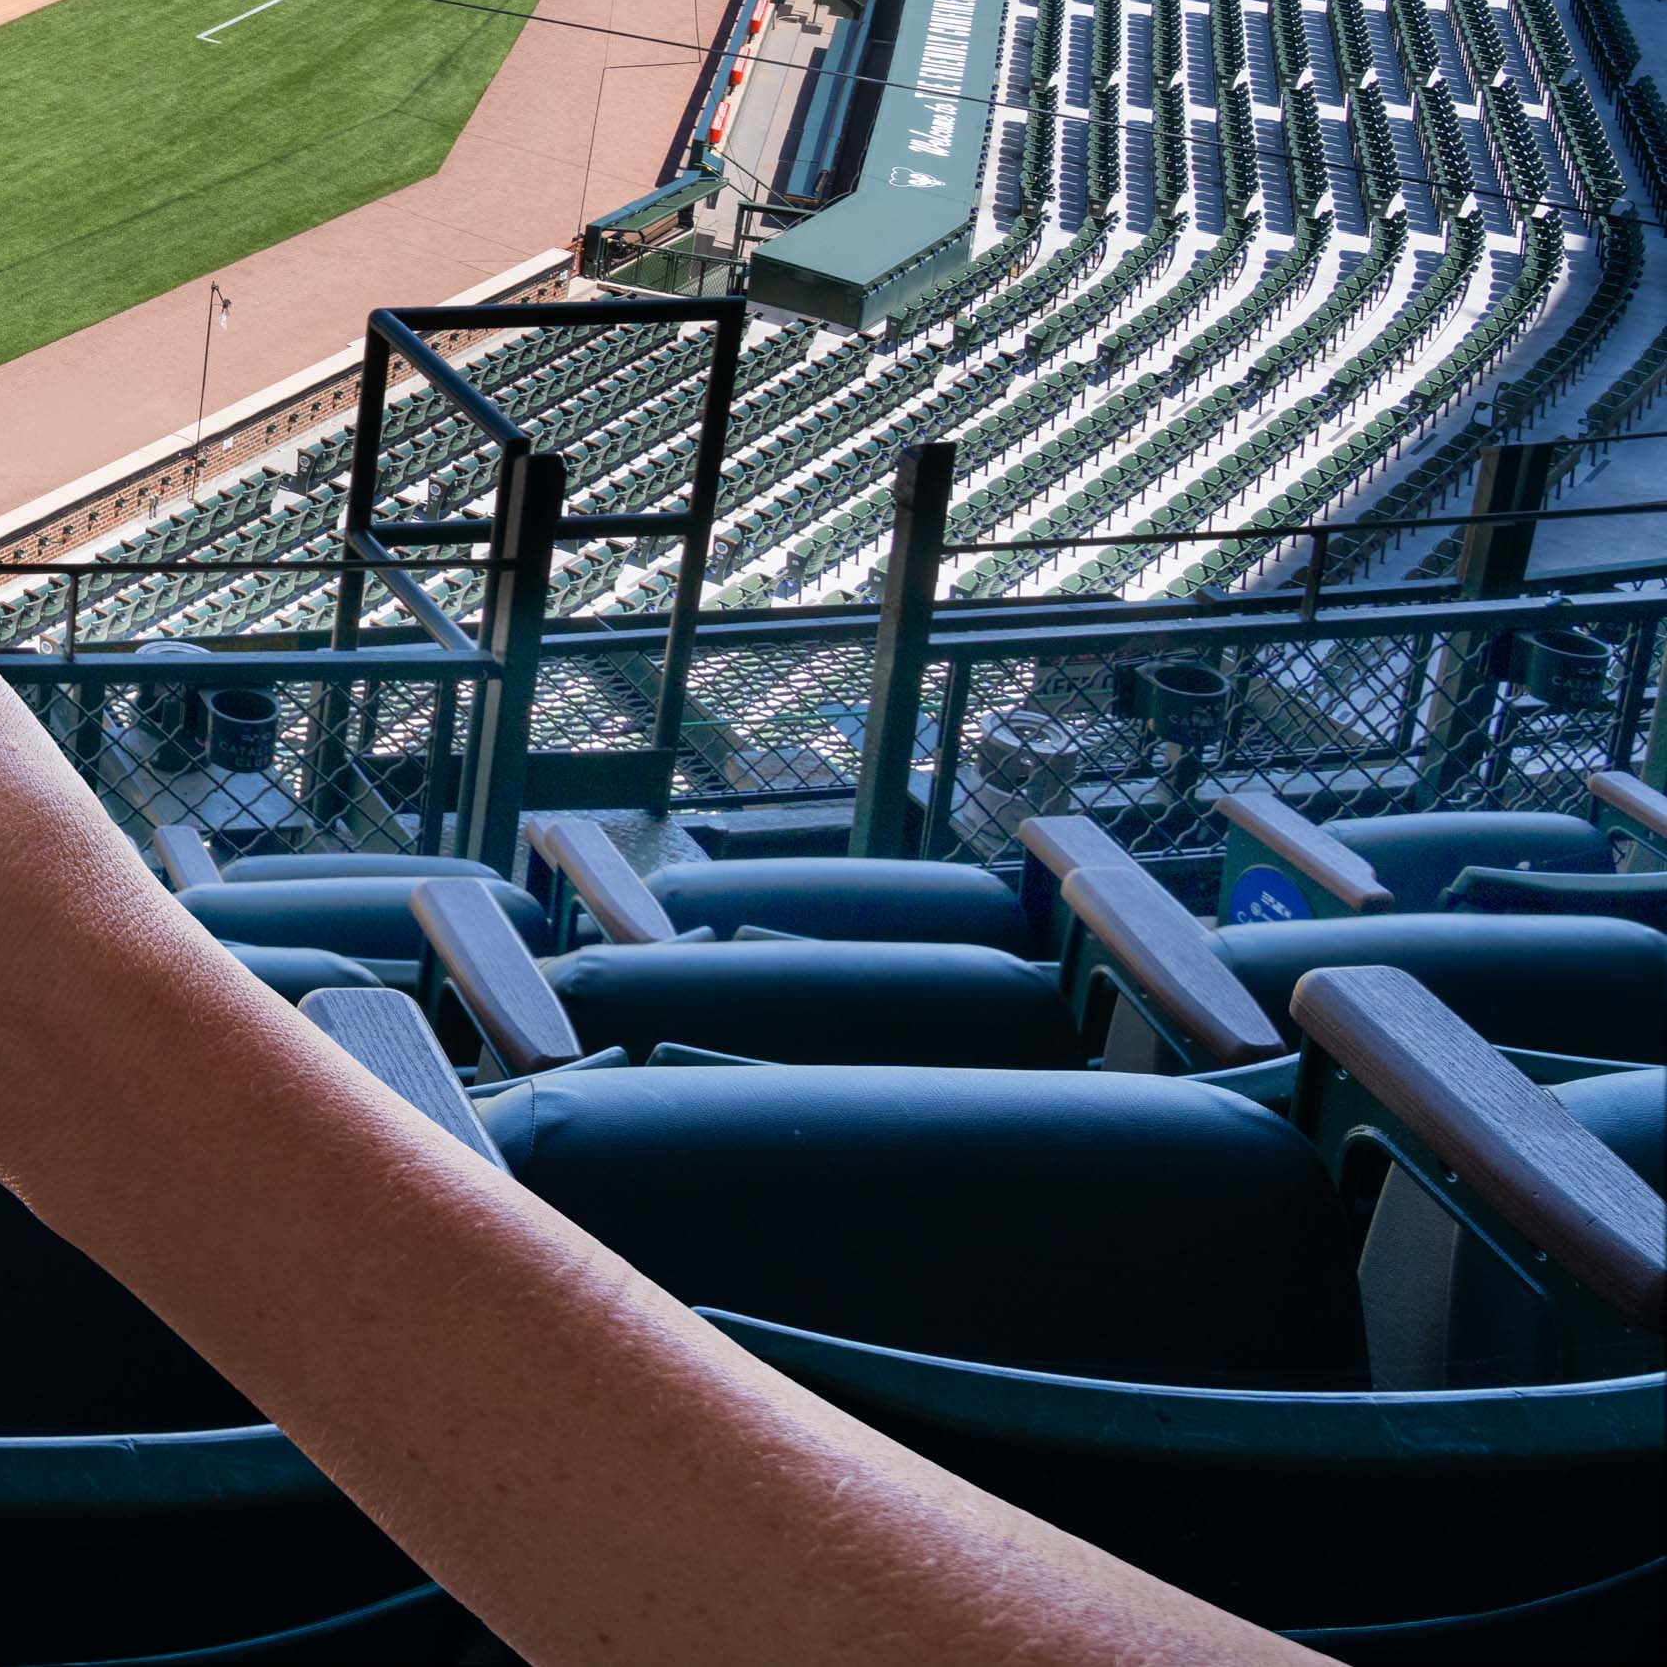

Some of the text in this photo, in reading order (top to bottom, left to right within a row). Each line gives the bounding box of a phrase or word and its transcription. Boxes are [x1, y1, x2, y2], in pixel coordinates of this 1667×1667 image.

[919, 34, 969, 82] FRIENDLY
[915, 80, 962, 102] THE
[924, 103, 958, 116] to
[908, 114, 957, 157] Welcome
